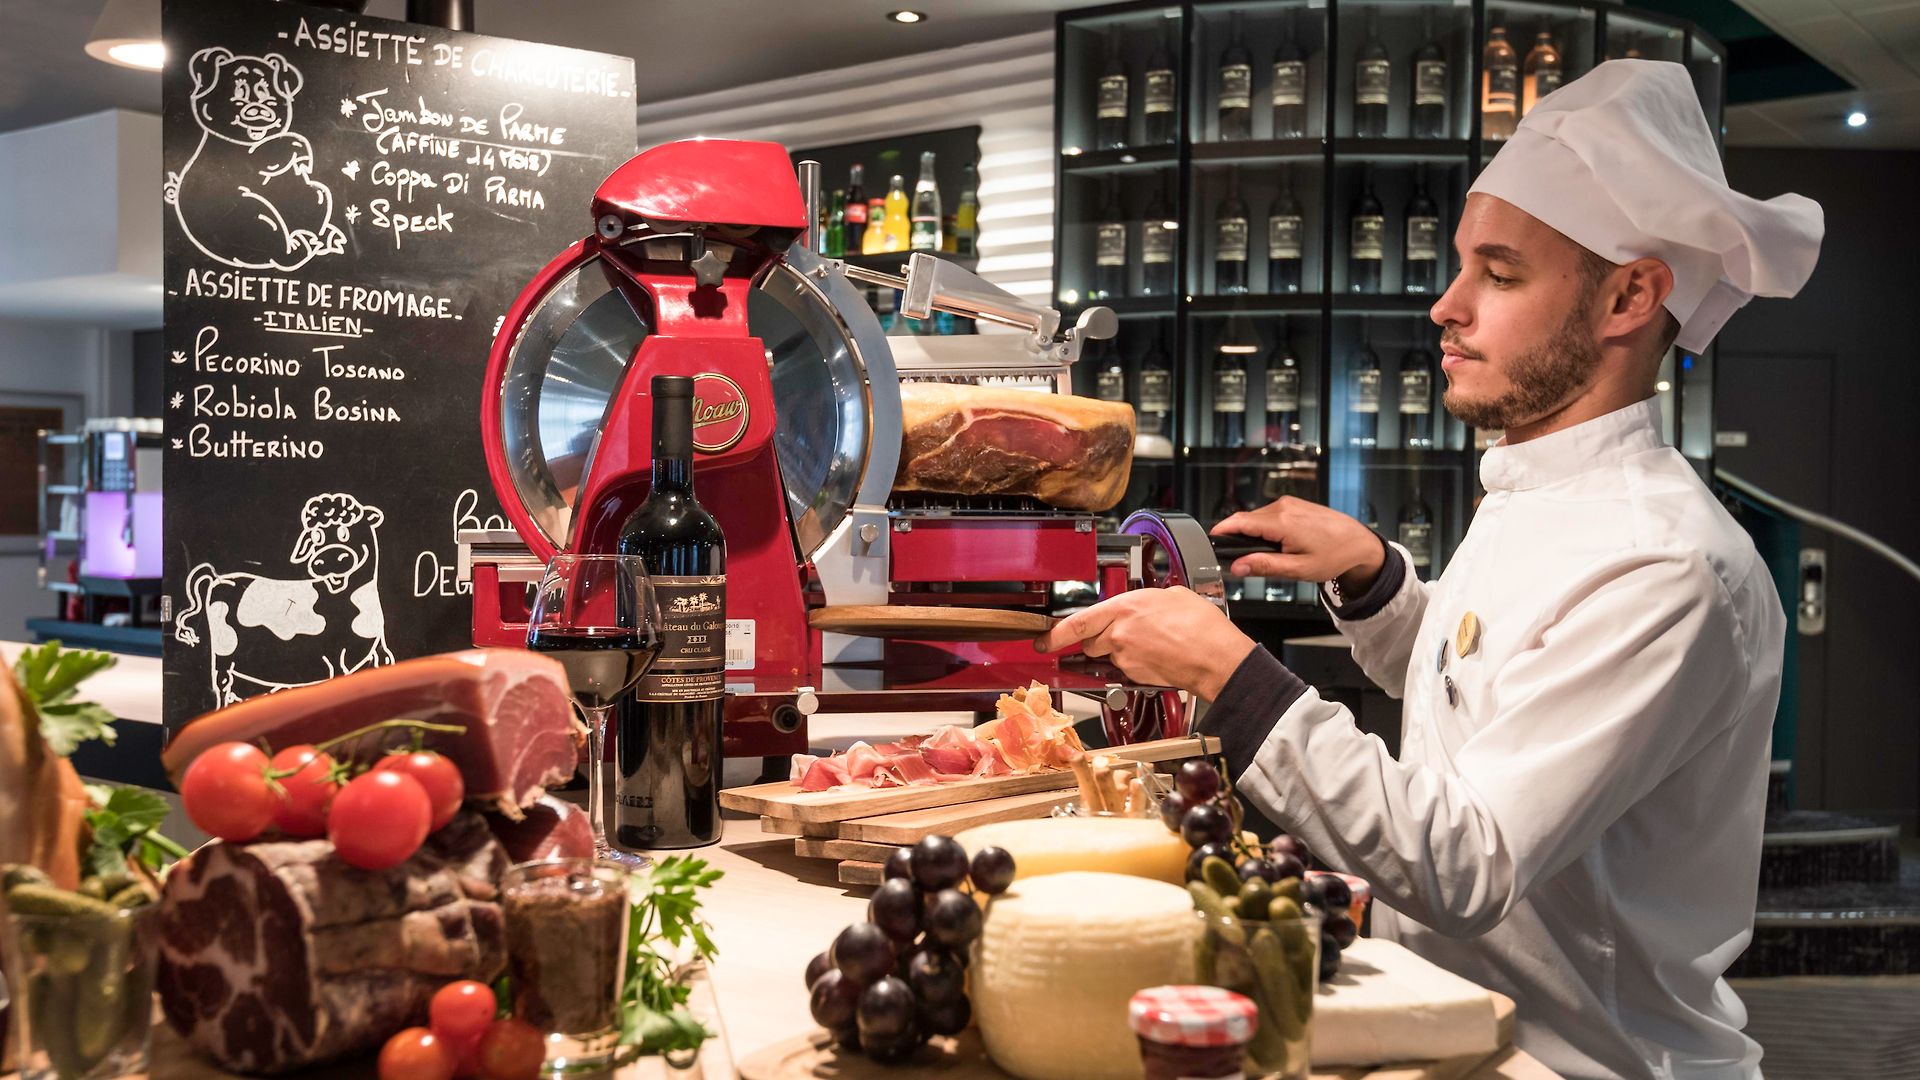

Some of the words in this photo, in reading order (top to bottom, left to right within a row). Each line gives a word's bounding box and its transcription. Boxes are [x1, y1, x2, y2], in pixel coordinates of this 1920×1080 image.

[434, 43, 463, 68] DE
[459, 116, 490, 135] DE
[466, 145, 495, 171] 14
[371, 160, 437, 203] Coppa
[307, 284, 332, 308] DE
